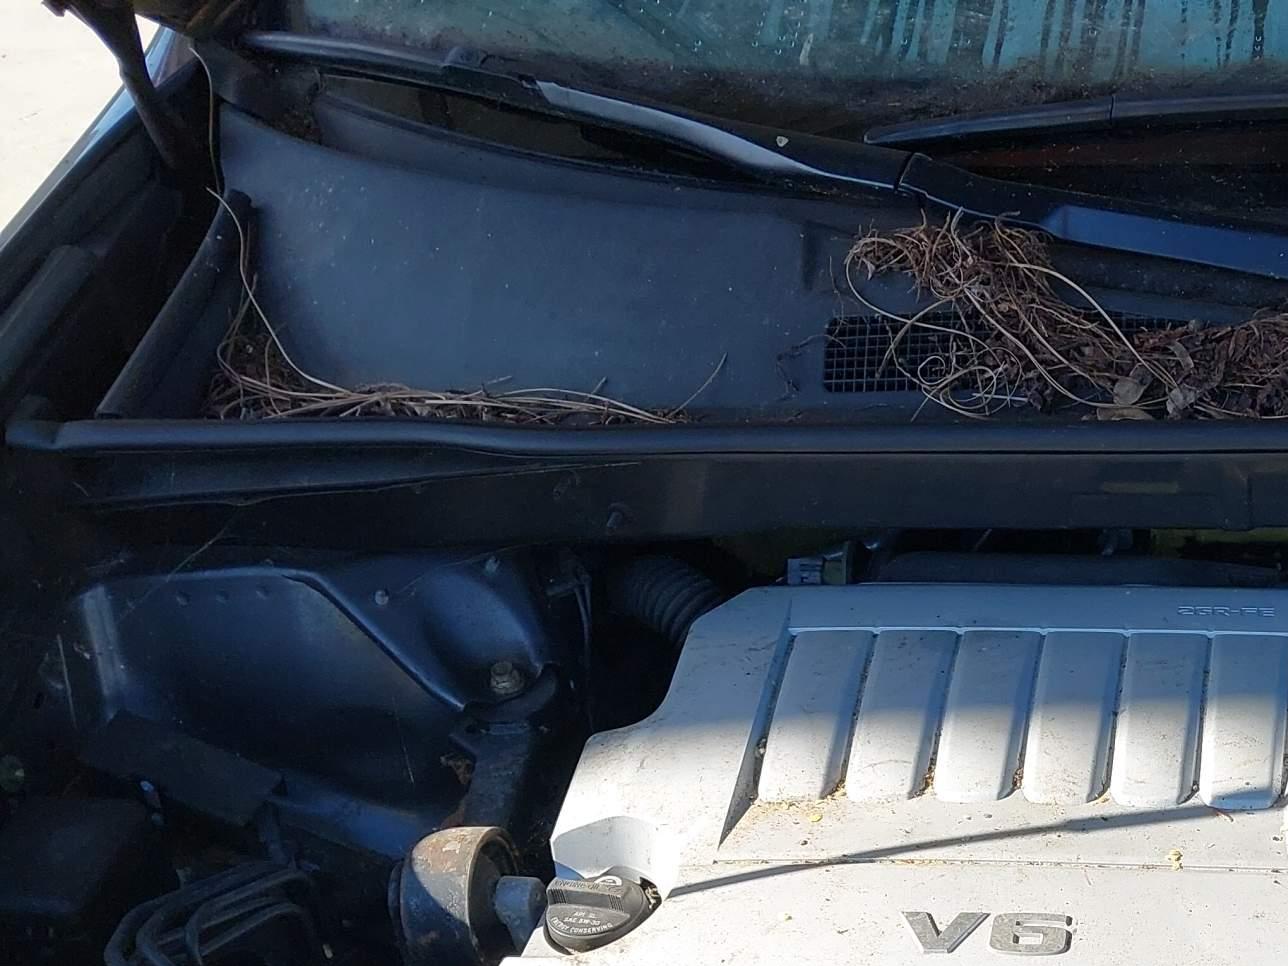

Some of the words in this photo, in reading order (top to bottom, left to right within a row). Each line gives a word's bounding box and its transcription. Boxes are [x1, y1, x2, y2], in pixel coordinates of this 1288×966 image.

[1178, 605, 1275, 617] 2GR-FE
[569, 922, 614, 934] CONSERVING
[902, 911, 1073, 956] V6
